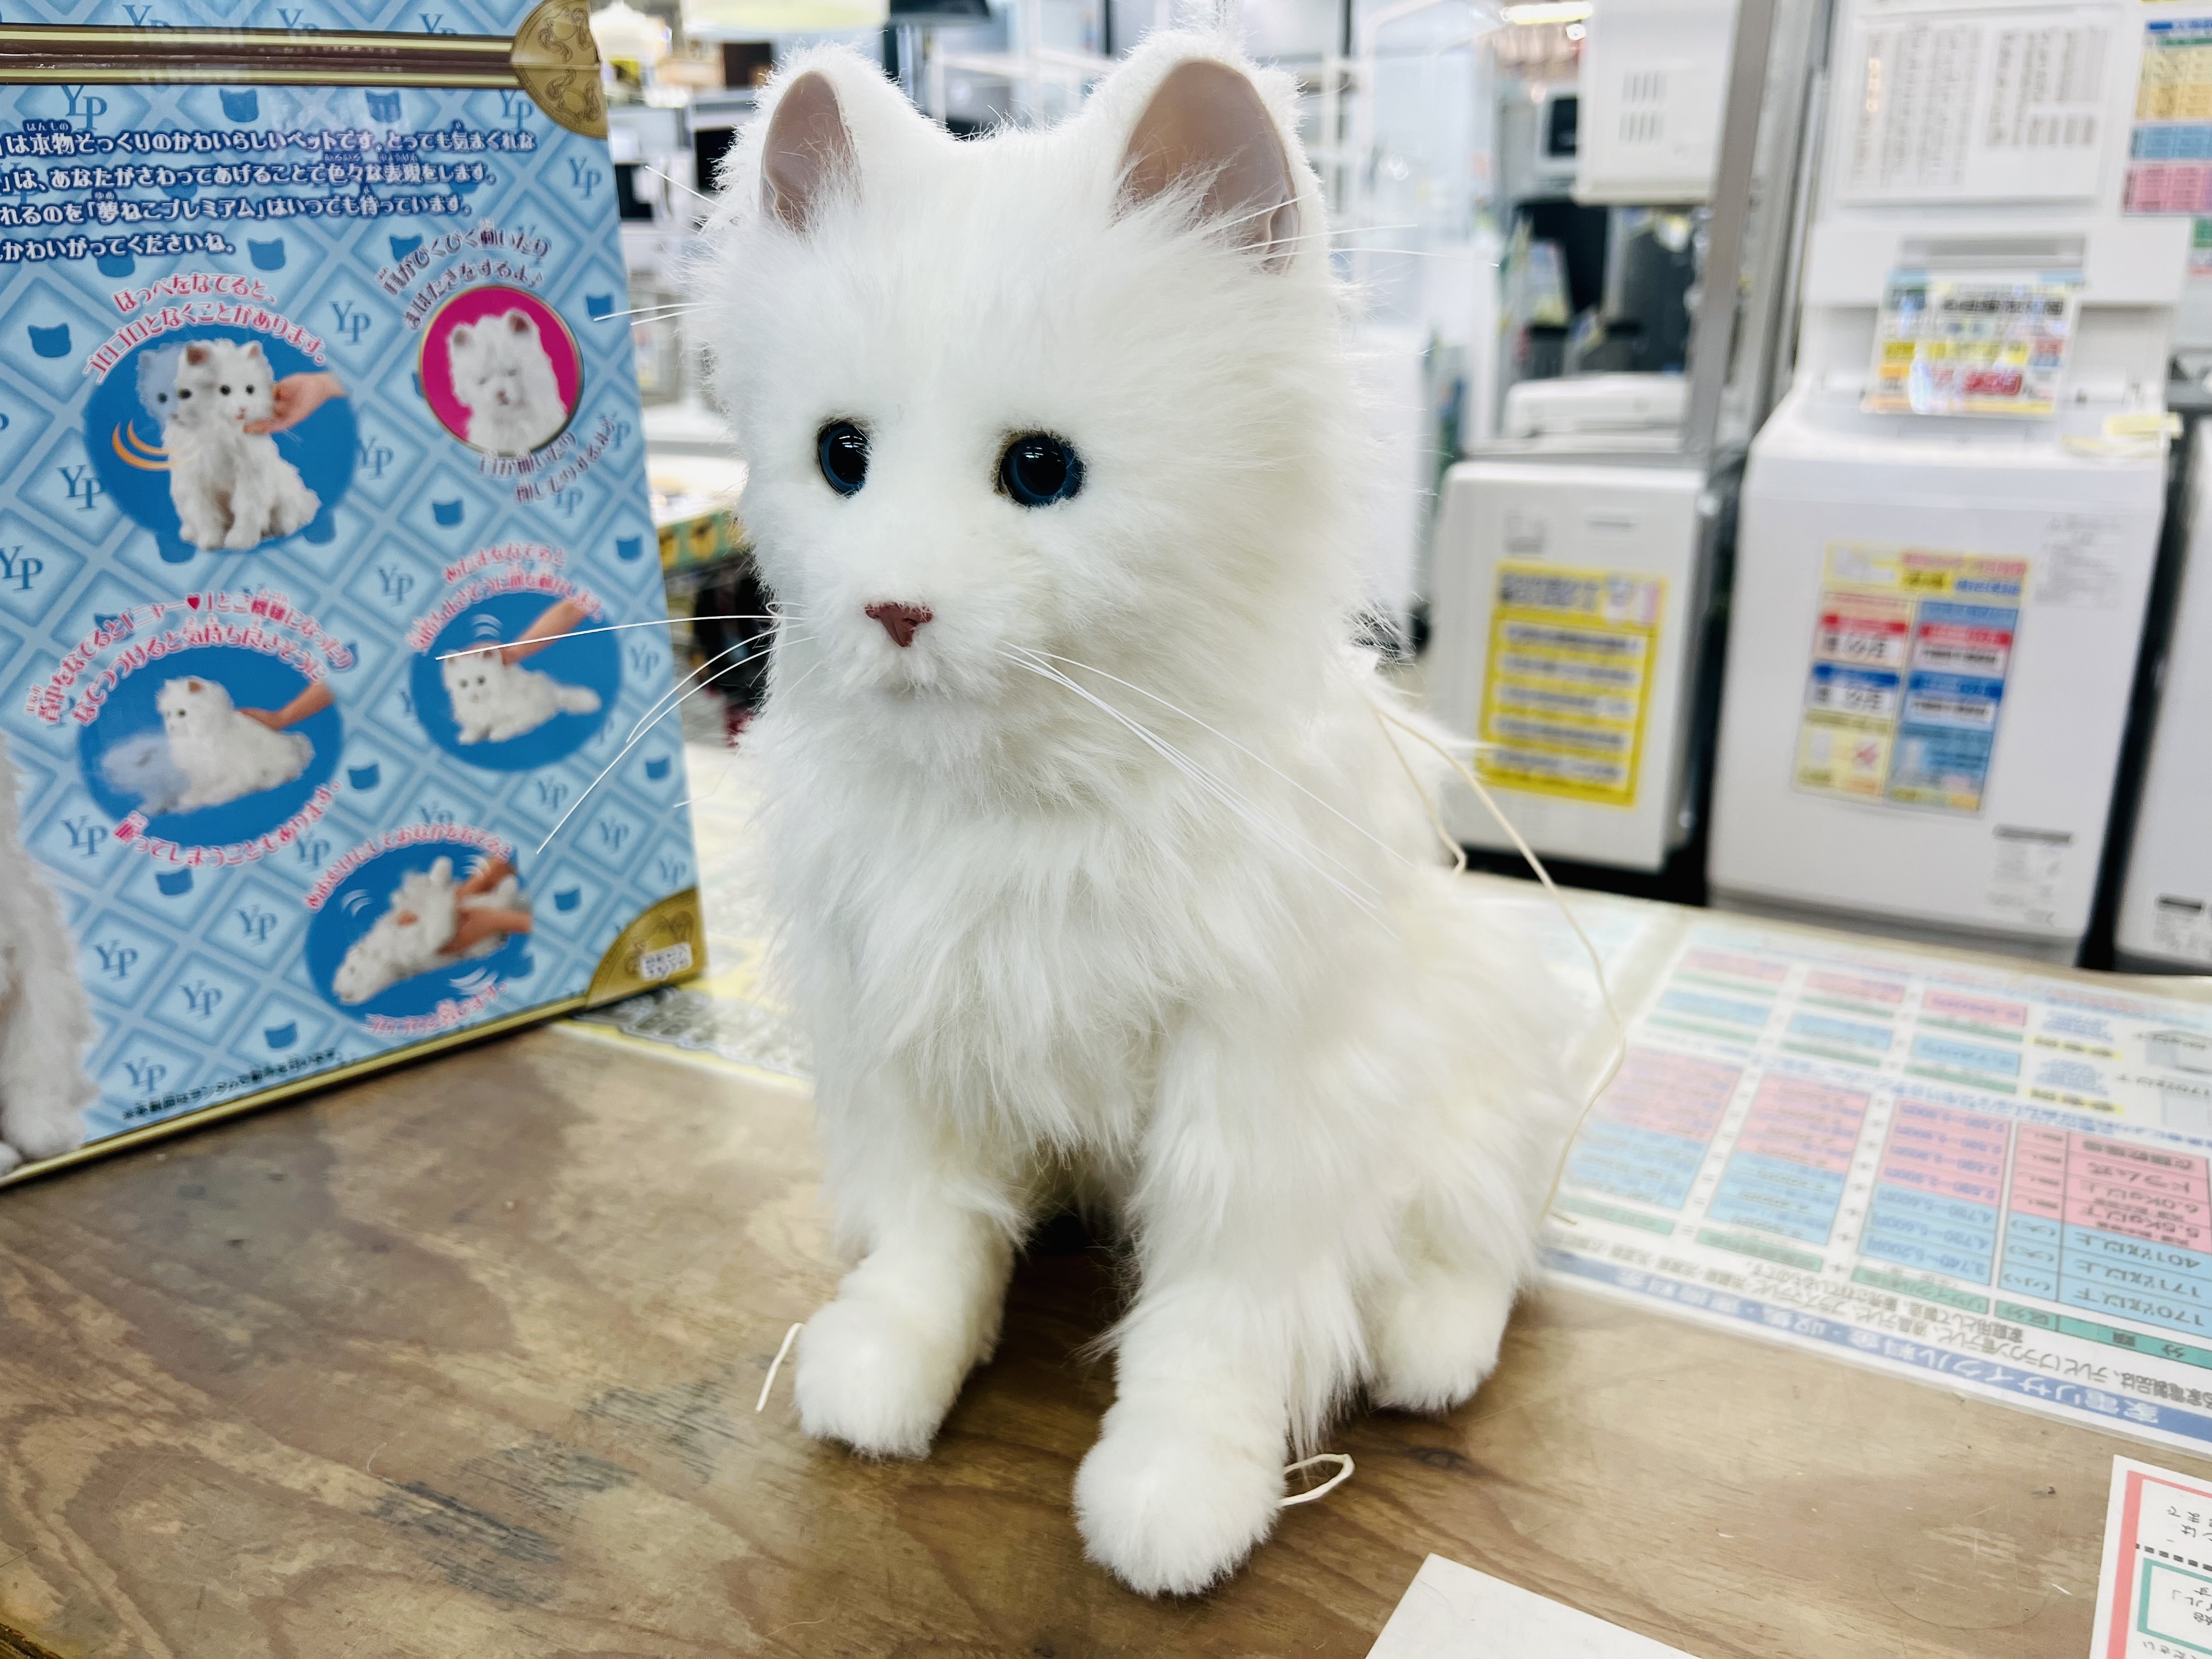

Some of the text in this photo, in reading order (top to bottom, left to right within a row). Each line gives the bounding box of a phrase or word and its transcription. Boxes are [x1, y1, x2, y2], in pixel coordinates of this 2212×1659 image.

[0, 233, 234, 262] かわいがってくださいね。
[2167, 1506, 2212, 1527] まで
